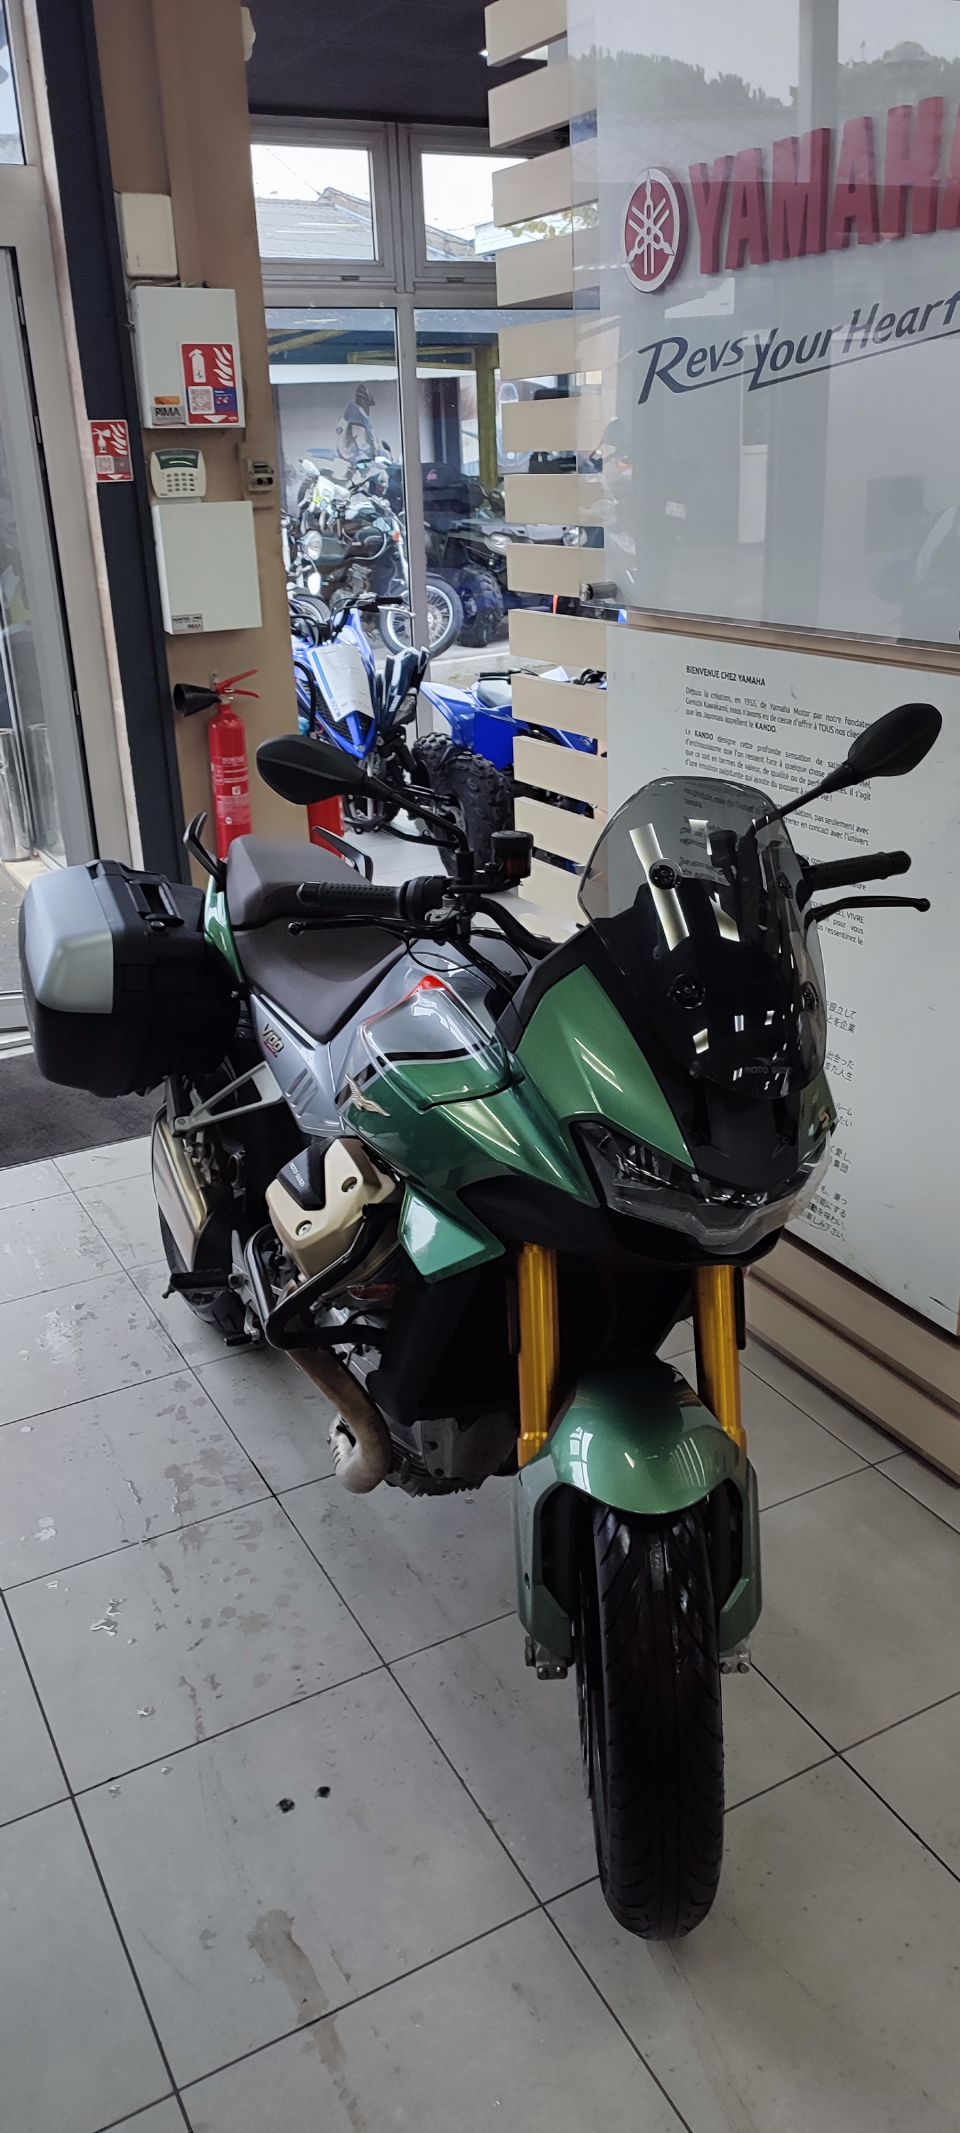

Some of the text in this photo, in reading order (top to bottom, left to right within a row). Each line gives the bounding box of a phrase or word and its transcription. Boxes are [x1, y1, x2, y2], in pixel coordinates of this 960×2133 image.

[637, 336, 749, 405] Revs
[747, 328, 843, 392] Your
[686, 665, 766, 687] BIENVENUE CHEZ YAMAHA
[770, 704, 791, 714] Yamaha
[793, 707, 811, 717] Motor
[813, 712, 823, 721] par
[825, 714, 842, 723] notre
[844, 716, 871, 730] fondate
[777, 716, 792, 726] cesse
[818, 723, 834, 734] TOUS
[835, 728, 846, 737] nos
[846, 729, 861, 739] clie
[694, 730, 714, 740] KANDO
[815, 756, 824, 766] de
[799, 776, 807, 785] de
[808, 768, 826, 778] chose
[855, 789, 872, 802] s'agit
[808, 824, 829, 835] contact
[829, 830, 844, 840] avec
[844, 833, 869, 847] l'univers
[814, 814, 825, 823] pas
[824, 817, 855, 832] seulement
[855, 826, 870, 836] avec
[833, 919, 864, 935] pour vous
[846, 911, 865, 925] VIVRE
[824, 926, 857, 943] ressentirez
[857, 936, 864, 946] le
[826, 1000, 857, 1020] 設立して
